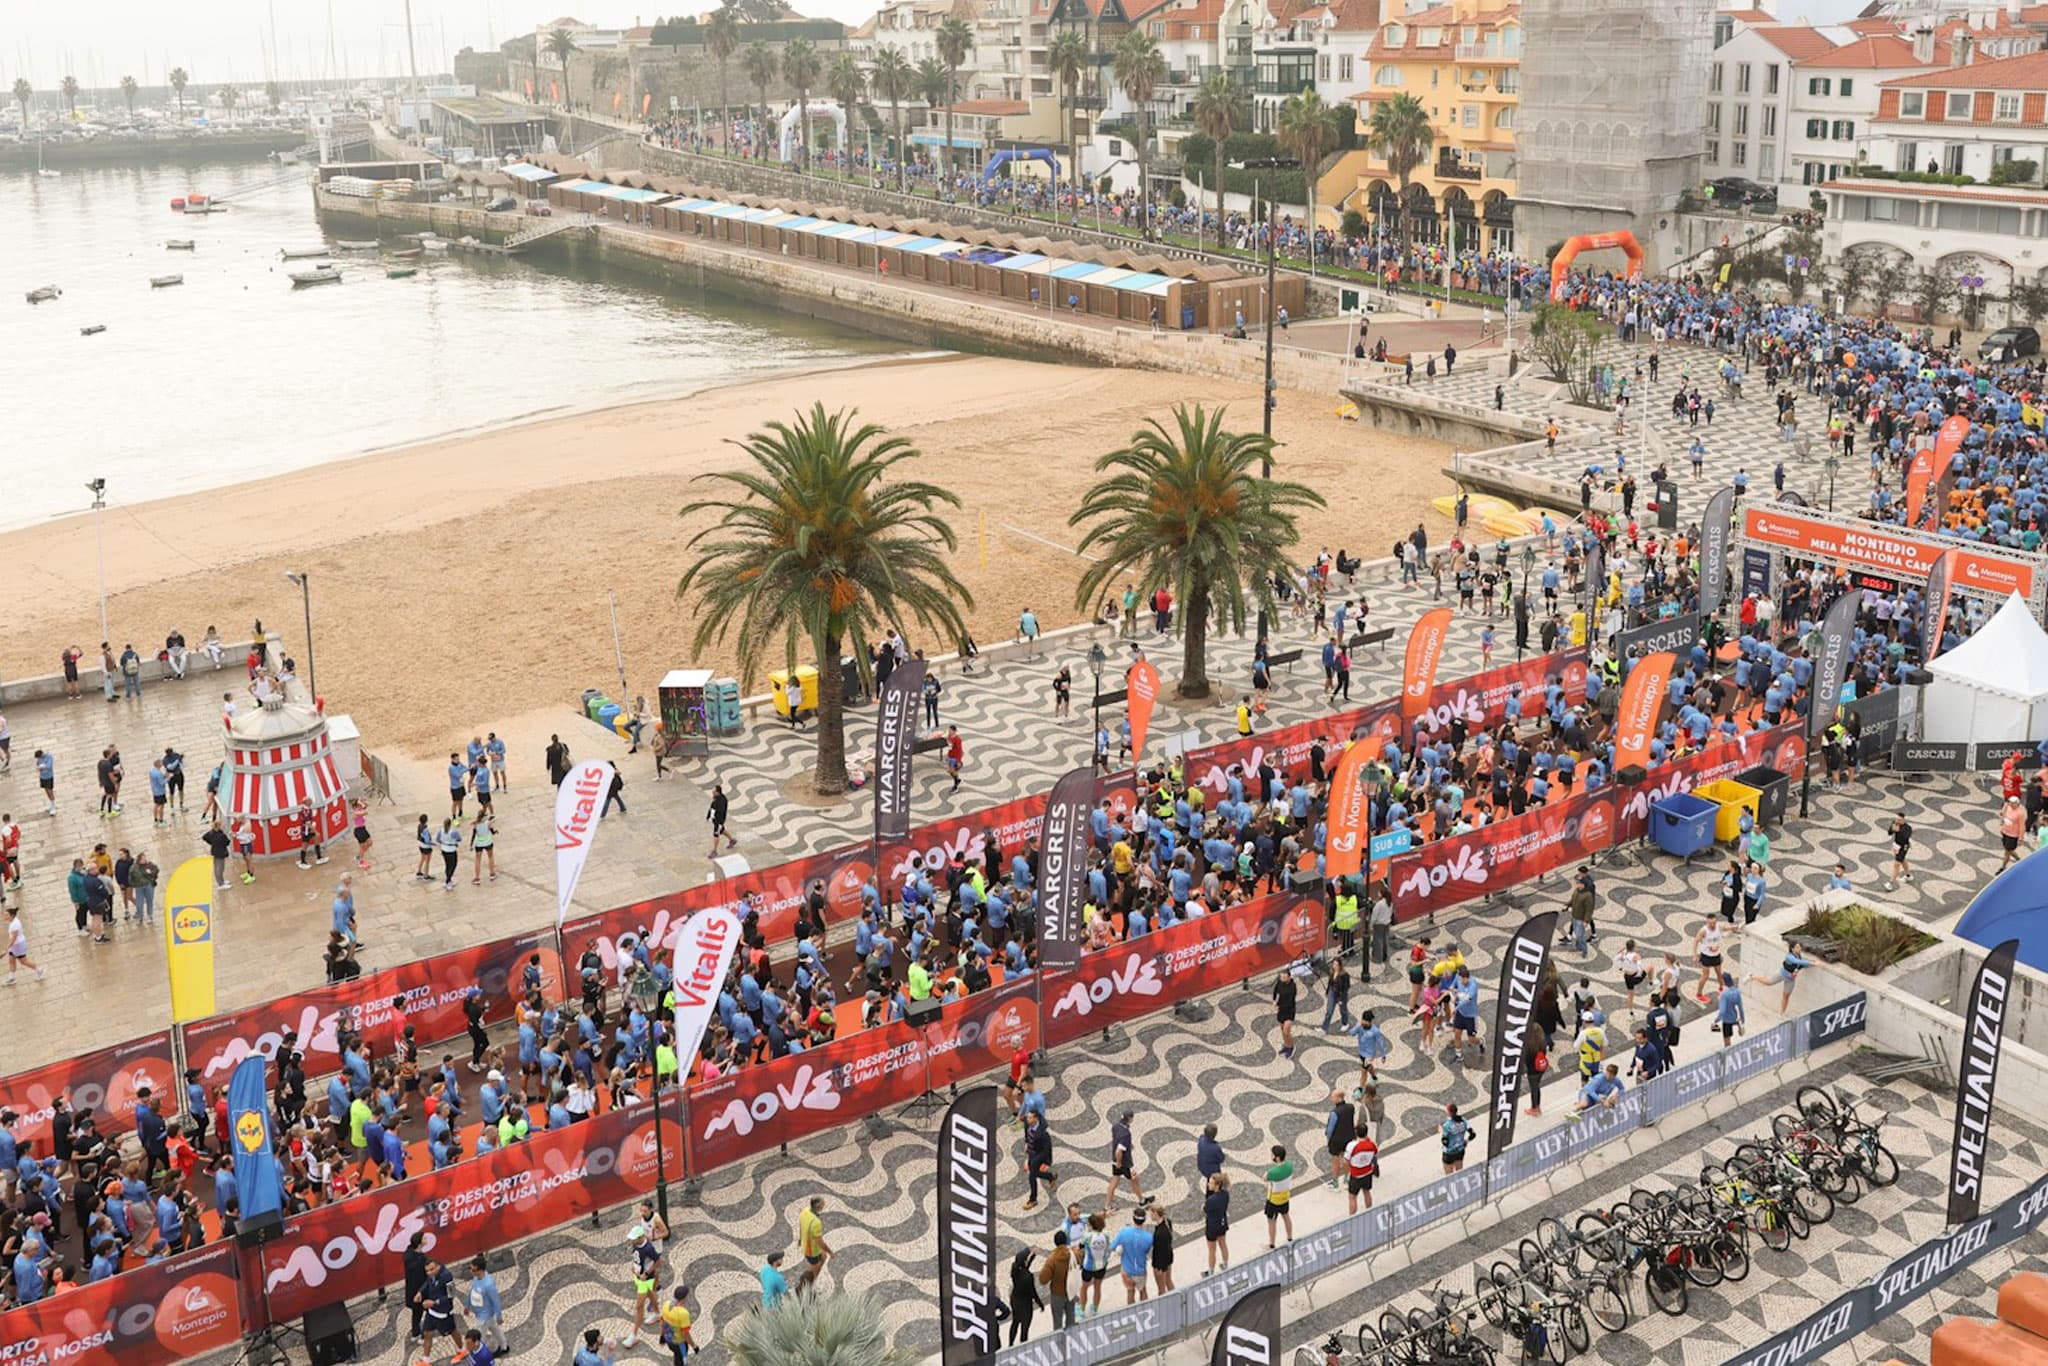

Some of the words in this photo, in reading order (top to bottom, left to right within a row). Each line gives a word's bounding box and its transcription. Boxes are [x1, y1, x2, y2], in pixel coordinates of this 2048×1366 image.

[1709, 526, 1721, 585] CASCAIS
[1810, 538, 1838, 553] MEIA
[1840, 543, 1903, 568] MARATONA
[1845, 532, 1917, 557] MONTEPIO
[1625, 627, 1692, 659] CSCAIS
[1821, 633, 1842, 700] CASCAIS
[906, 692, 917, 732] TILES
[1635, 674, 1660, 730] Montepio
[880, 689, 901, 814] MARGRES
[1906, 750, 1956, 760] CASCAIS
[555, 767, 604, 849] Vitalis
[1043, 802, 1067, 940] MARGRES
[1374, 840, 1394, 853] SUB
[1395, 834, 1408, 846] 45
[1398, 844, 1488, 898] MOVE
[1069, 864, 1081, 942] CERAMIC
[1075, 804, 1086, 850] TILES
[674, 917, 729, 1008] Vitalis
[1173, 959, 1196, 974] UMA
[1198, 945, 1230, 966] CAUSA
[1175, 934, 1227, 962] DESPORTO
[1052, 953, 1162, 1018] MOVE
[365, 1010, 393, 1029] UMA
[1495, 936, 1544, 1129] SPECIALIZED
[843, 1062, 853, 1075] O
[855, 1039, 918, 1070] DESPORTO
[854, 1067, 881, 1085] UMA
[884, 1052, 922, 1075] CAUSA
[1955, 967, 2008, 1200] SPECIALIZED
[703, 1065, 841, 1141] MOVE
[438, 1199, 450, 1213] O
[455, 1170, 532, 1208] DESPORTO
[453, 1204, 486, 1224] UMA
[489, 1184, 538, 1210] CAUSA
[541, 1165, 589, 1191] NOSSA
[264, 1203, 437, 1295] MOVE
[951, 1113, 989, 1353] SPECIALIZED
[1874, 1218, 1993, 1311] SPECIALIZED
[53, 1328, 115, 1361] NOSSA
[172, 1311, 228, 1336] Montepio
